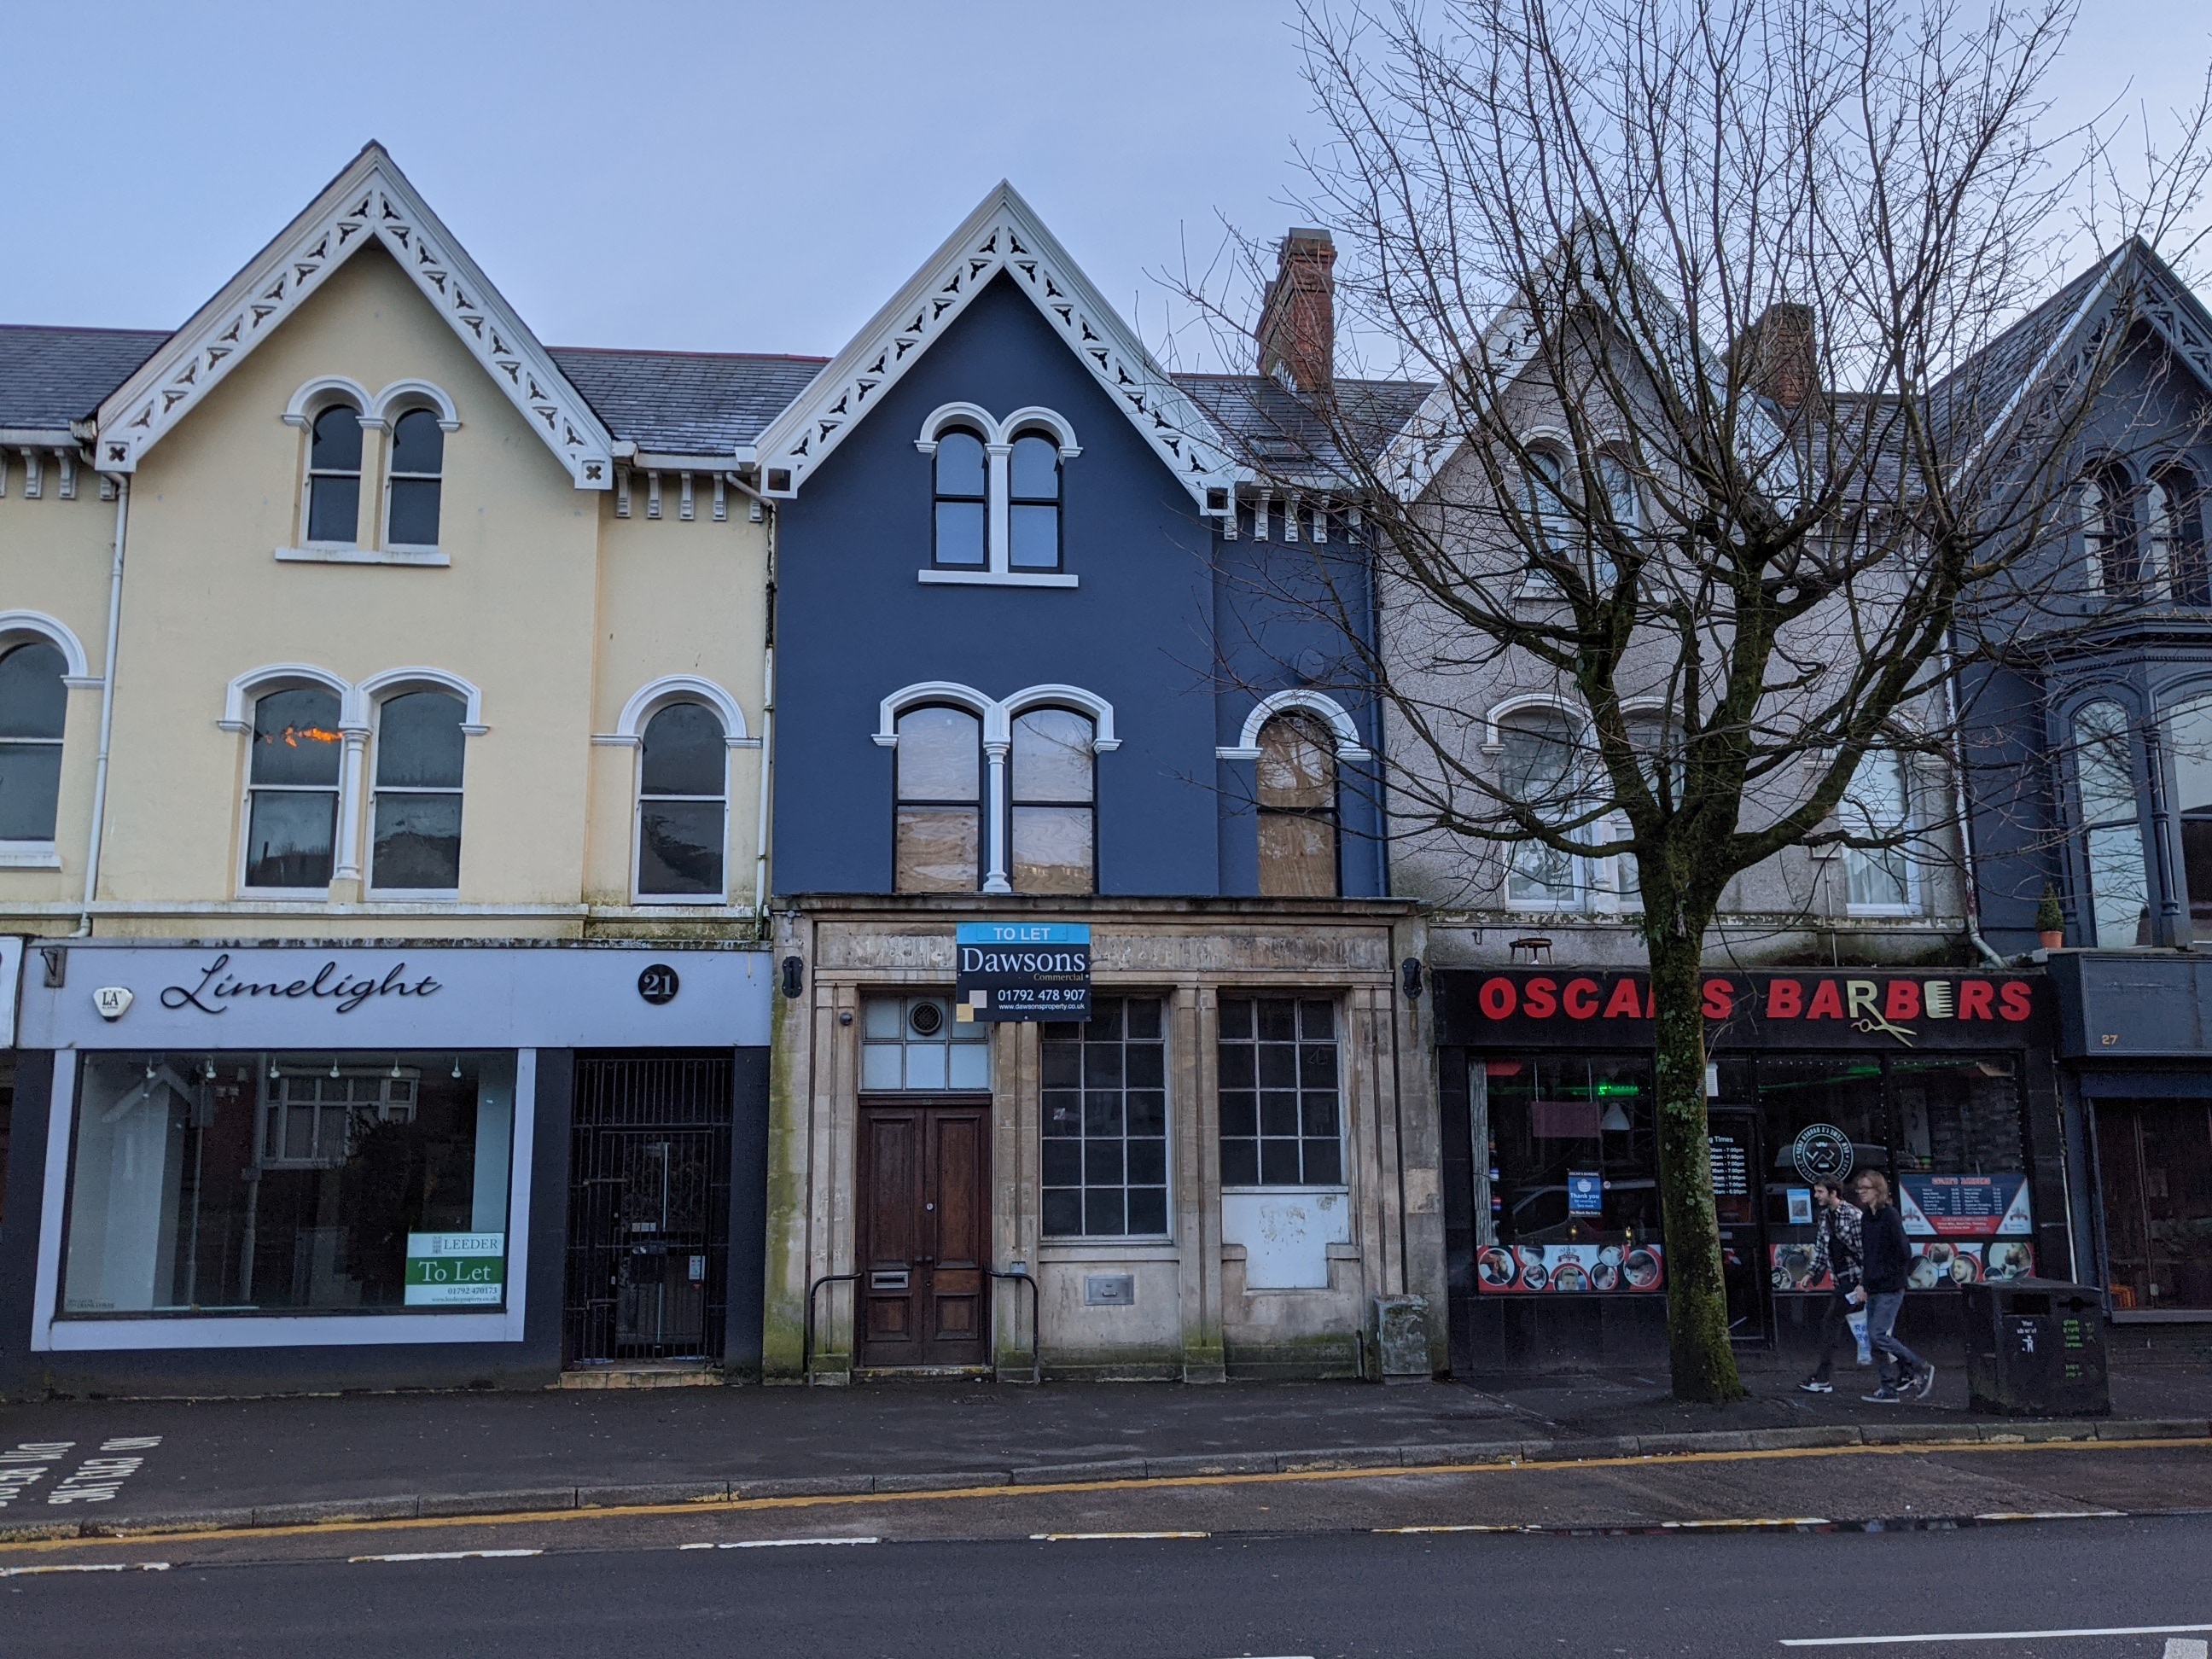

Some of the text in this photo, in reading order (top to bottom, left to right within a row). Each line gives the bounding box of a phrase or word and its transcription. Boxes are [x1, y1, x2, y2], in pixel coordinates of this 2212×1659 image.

[993, 928, 1051, 940] TO LET
[962, 947, 1086, 973] Dawsons
[160, 953, 442, 1015] Limelight
[643, 974, 673, 995] 21
[1033, 973, 1084, 981] Commercial
[102, 991, 119, 1006] LA
[998, 989, 1086, 1001] 01792 478 907
[1479, 977, 2032, 1022] OSCAS BARBERS
[998, 1003, 1086, 1011] www.dawsonsproperty.co.uk
[2102, 1034, 2118, 1045] 27
[443, 1238, 498, 1250] LEEDER
[418, 1261, 492, 1281] To Let
[48, 1435, 164, 1504] NO CYCLING
